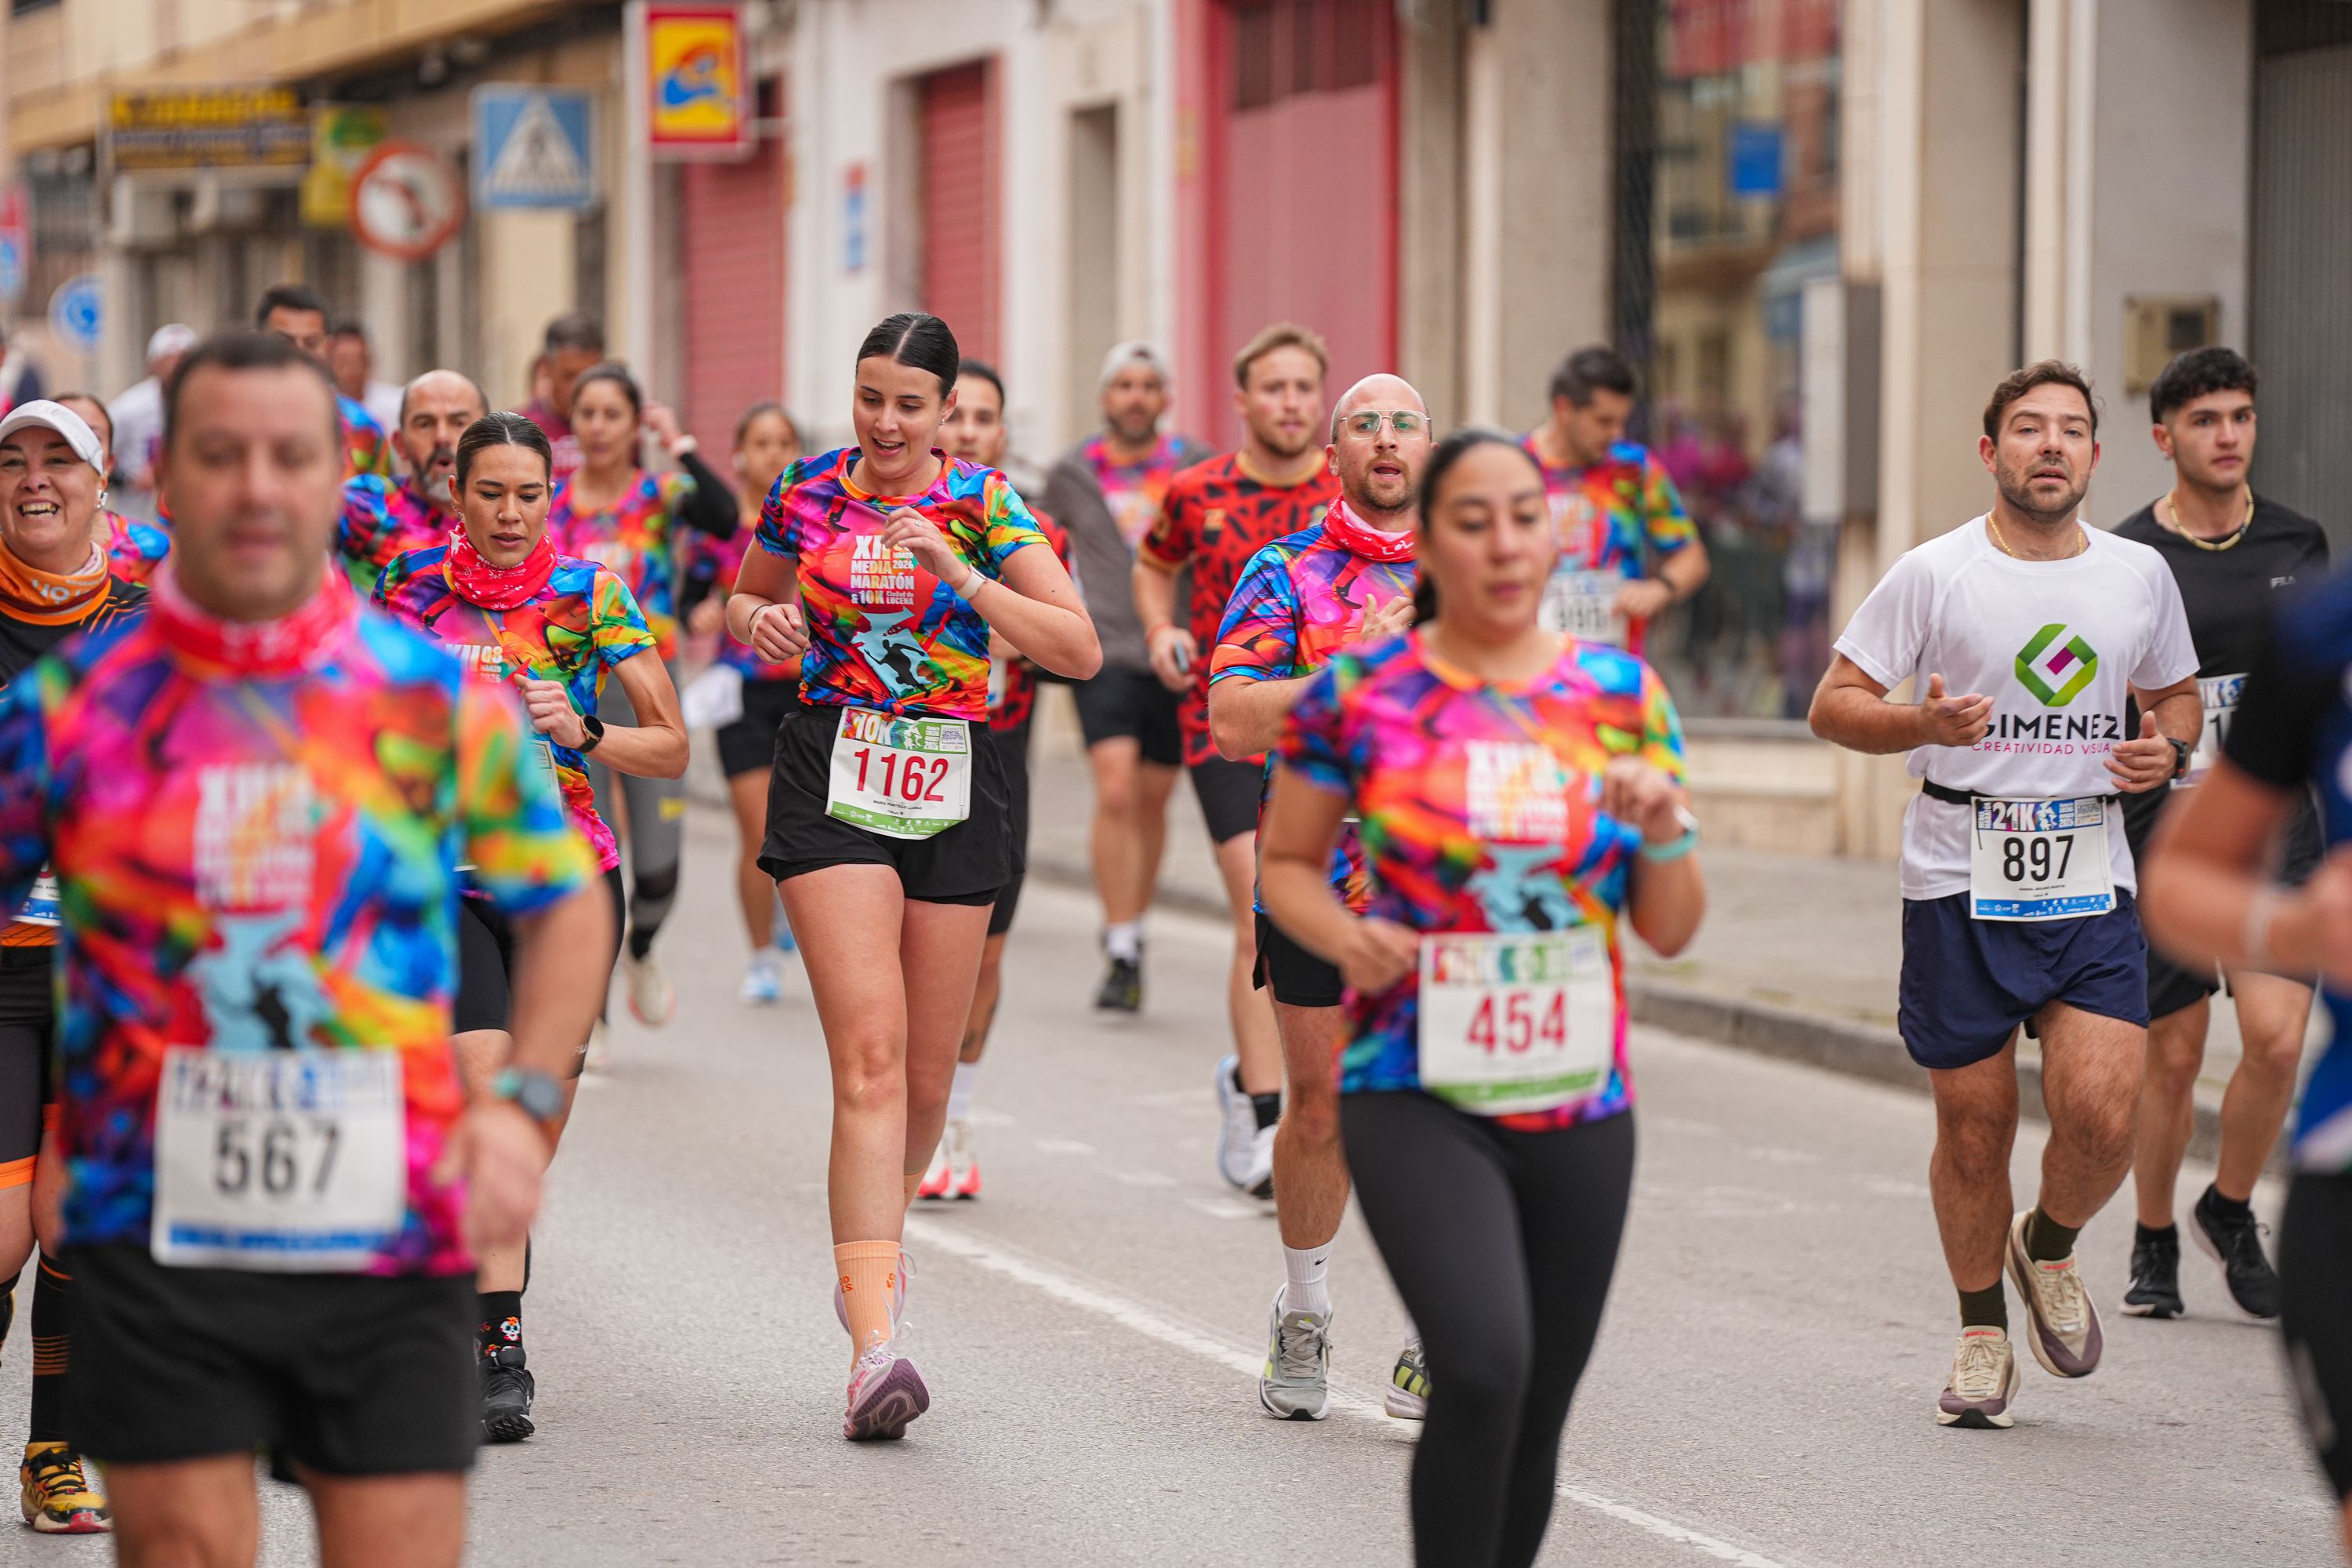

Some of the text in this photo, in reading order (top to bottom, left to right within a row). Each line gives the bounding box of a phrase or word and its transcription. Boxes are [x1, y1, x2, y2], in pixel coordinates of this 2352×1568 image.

[851, 561, 892, 574] MEDIA
[851, 572, 915, 590] MARATÓN
[851, 590, 884, 604] & 10K
[886, 597, 914, 605] LUCENA
[481, 645, 503, 664] 08
[854, 713, 896, 746] 10K
[1972, 742, 2074, 755] CREATIVIDAD
[854, 747, 949, 802] 1162
[1992, 801, 2036, 831] 21K
[2003, 834, 2074, 882] 897
[1466, 988, 1566, 1054] 454
[215, 1120, 342, 1196] 567
